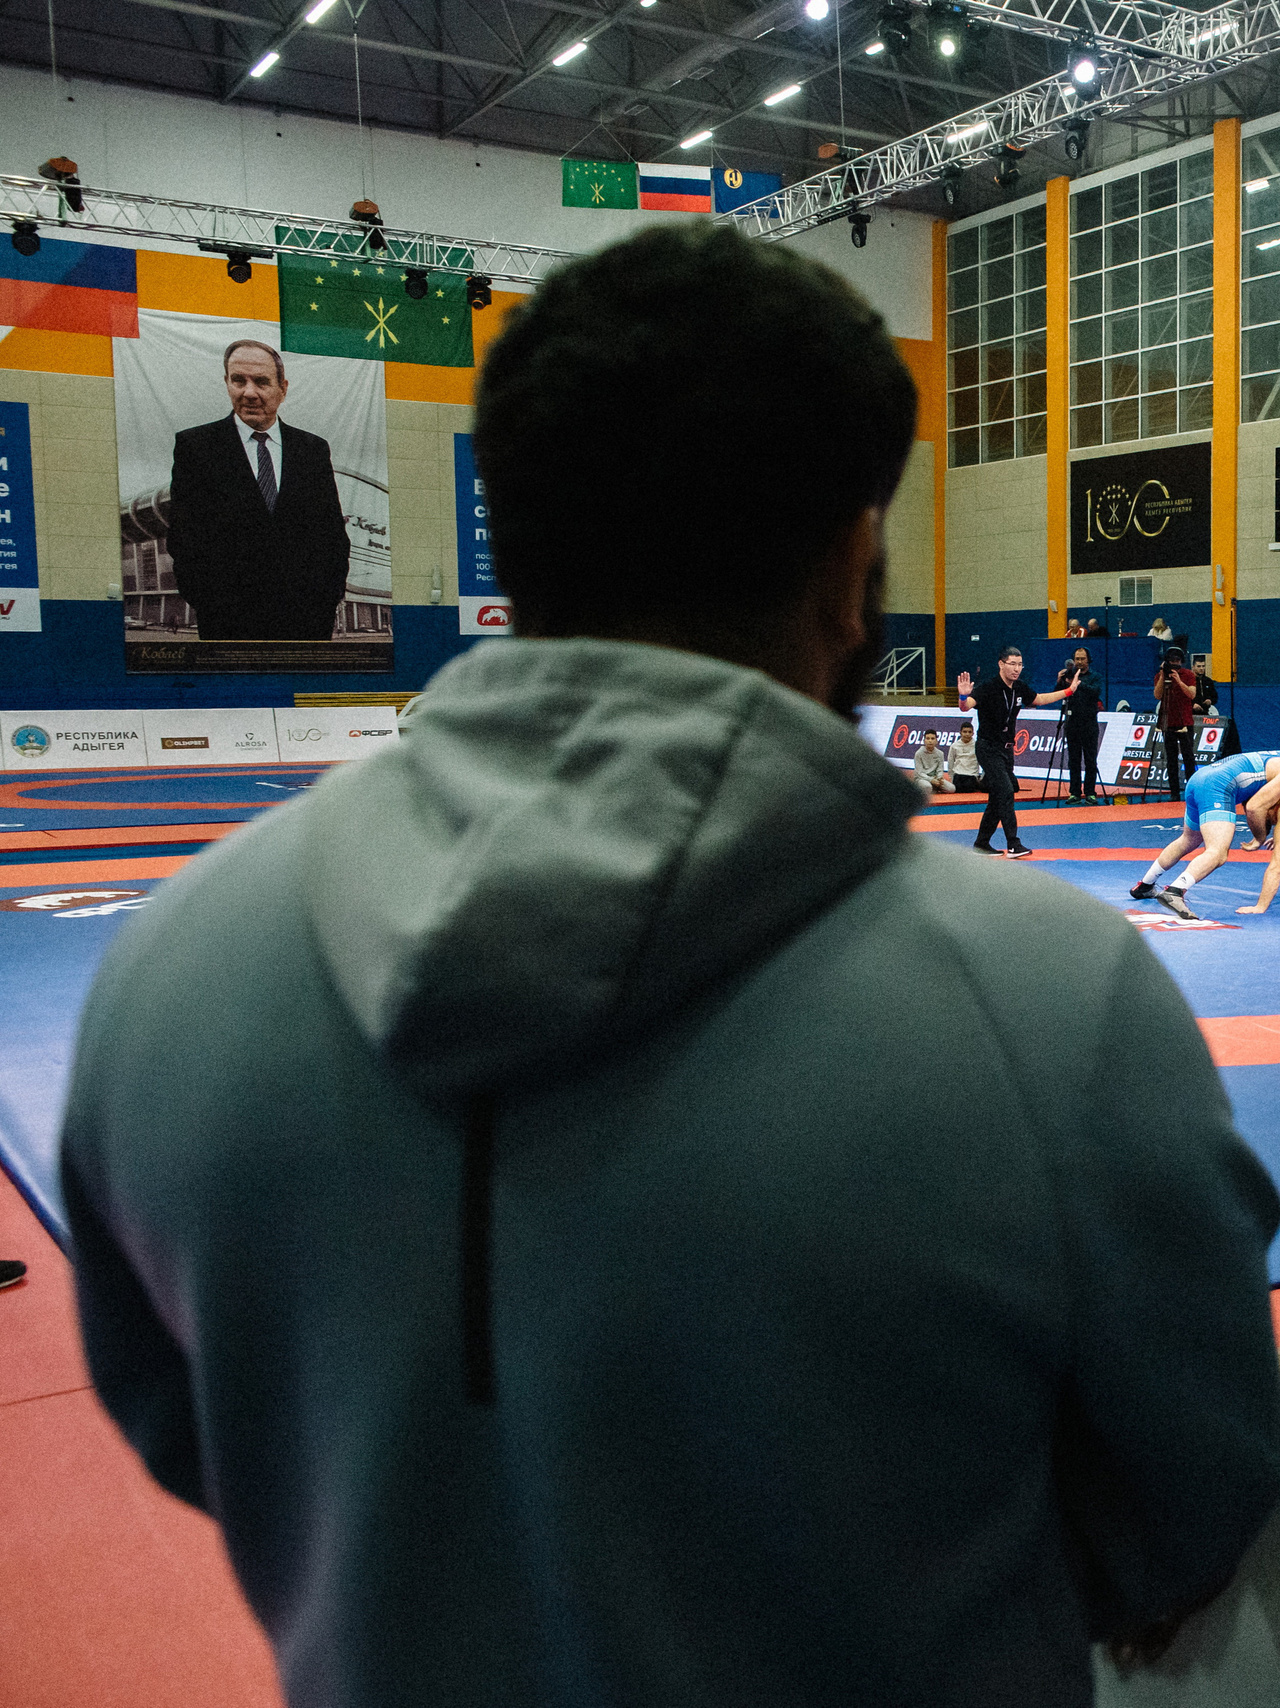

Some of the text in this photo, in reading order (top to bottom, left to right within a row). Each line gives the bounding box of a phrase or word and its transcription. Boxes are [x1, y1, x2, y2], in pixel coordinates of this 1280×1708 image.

[56, 731, 139, 741] РЕСПУБЛИКА
[72, 742, 125, 752] АДЫГЕЯ
[1122, 762, 1144, 780] 26
